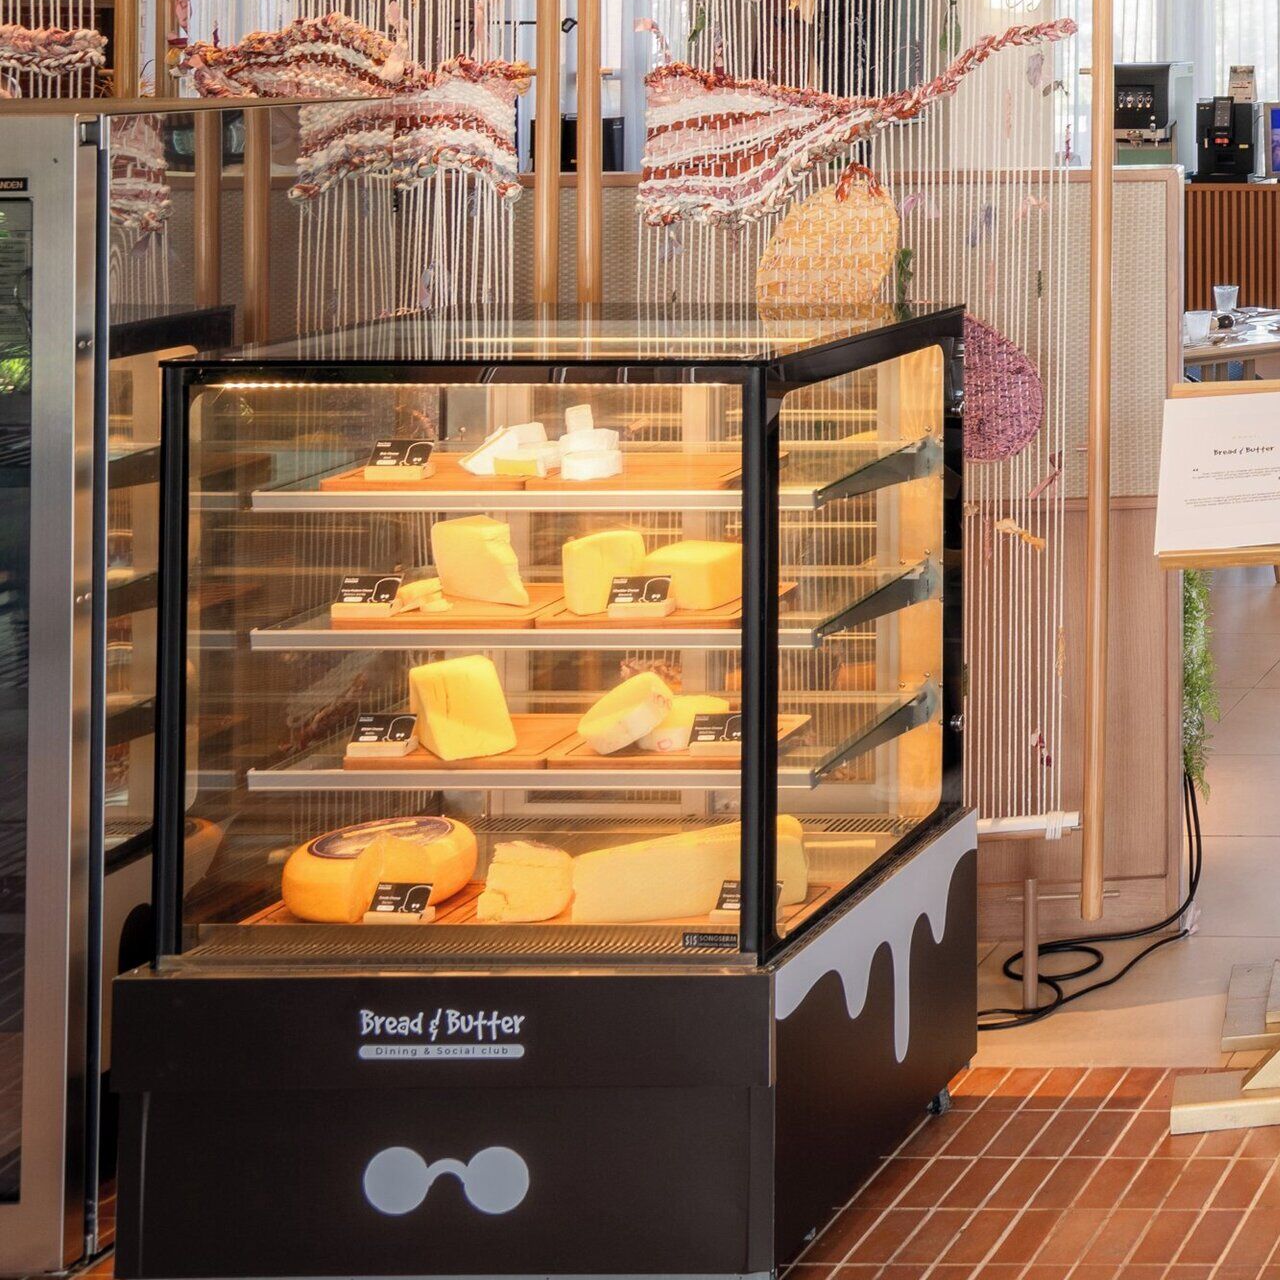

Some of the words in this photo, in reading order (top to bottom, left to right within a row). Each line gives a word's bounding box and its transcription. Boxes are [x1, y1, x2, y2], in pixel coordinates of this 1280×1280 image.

[1245, 445, 1275, 454] Butter
[359, 1009, 424, 1036] Bread
[428, 1007, 443, 1042] &
[445, 1008, 526, 1041] Butter
[374, 1046, 418, 1056] Dining
[423, 1046, 431, 1055] &
[436, 1046, 476, 1055] Social
[481, 1046, 510, 1055] club
